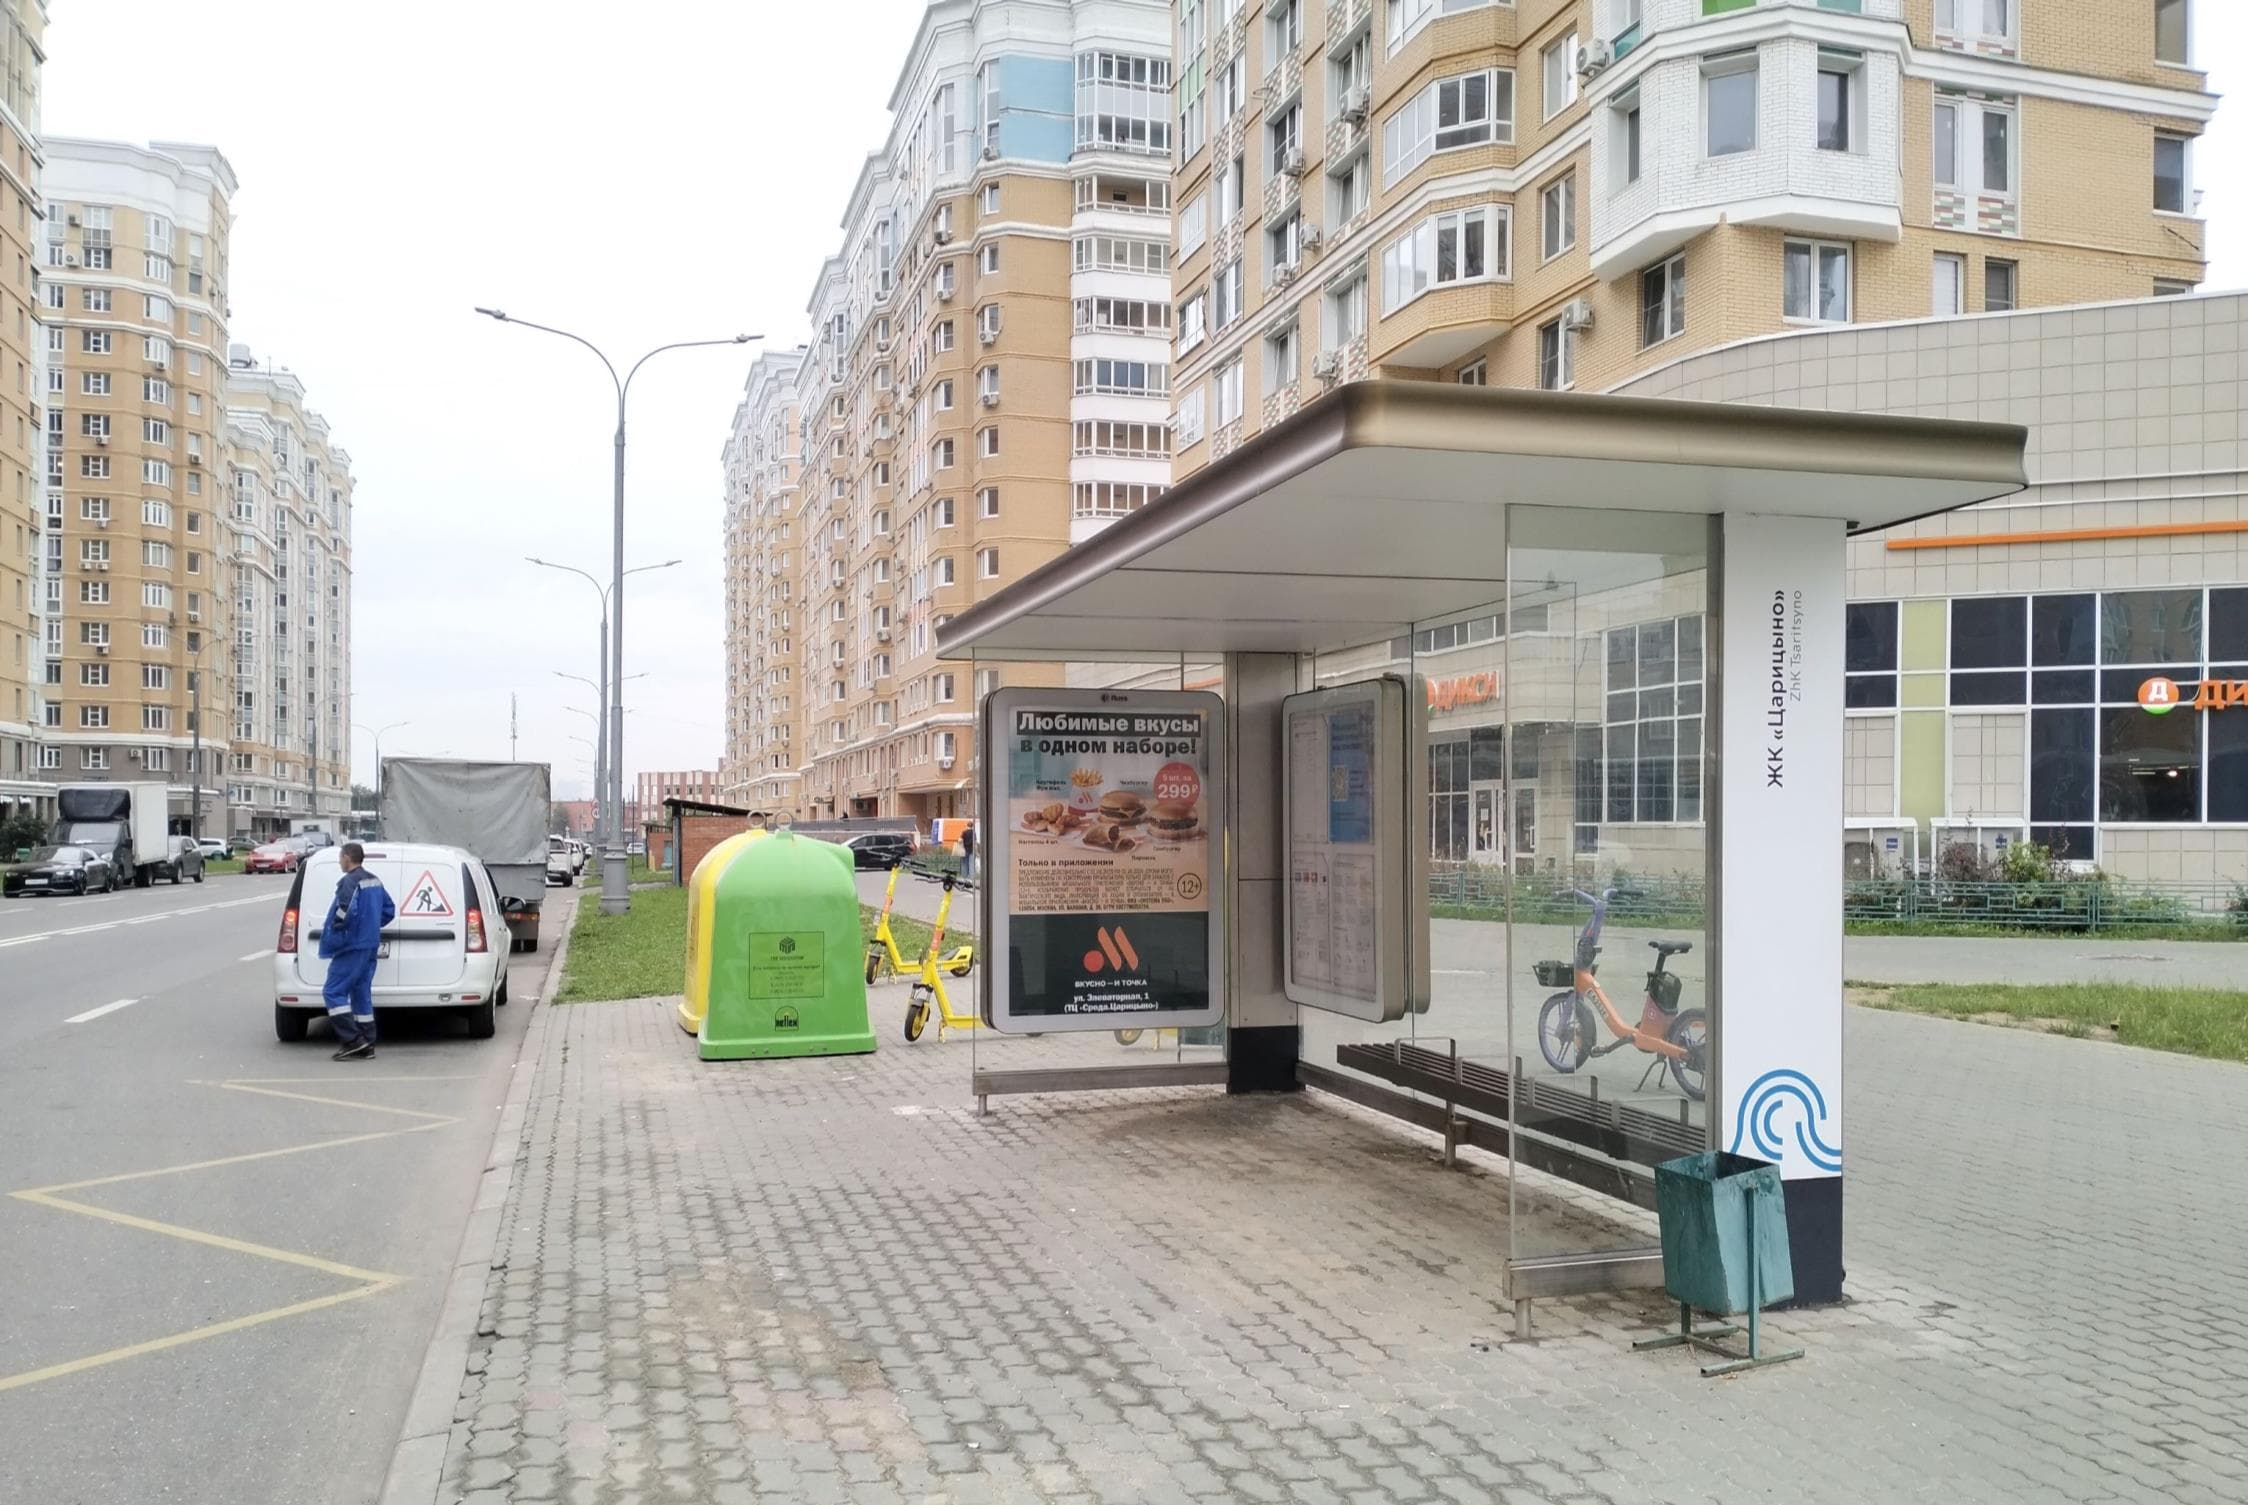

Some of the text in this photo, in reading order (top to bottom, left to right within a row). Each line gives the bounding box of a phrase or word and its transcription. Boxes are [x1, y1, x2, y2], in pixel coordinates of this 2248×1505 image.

[1790, 590, 1804, 702] ZhK Tsaritsyno
[1767, 590, 1787, 788] ЖК «Царицыно»
[1019, 712, 1199, 735] Любимые вкусы
[1020, 738, 1196, 757] в одном наборе!
[1018, 859, 1048, 867] Только
[1058, 859, 1114, 867] приложении
[1181, 880, 1199, 894] 12+
[1074, 980, 1106, 988] ВКУСНО
[1122, 979, 1148, 987] ТОЧКА
[1144, 992, 1150, 1000] 1
